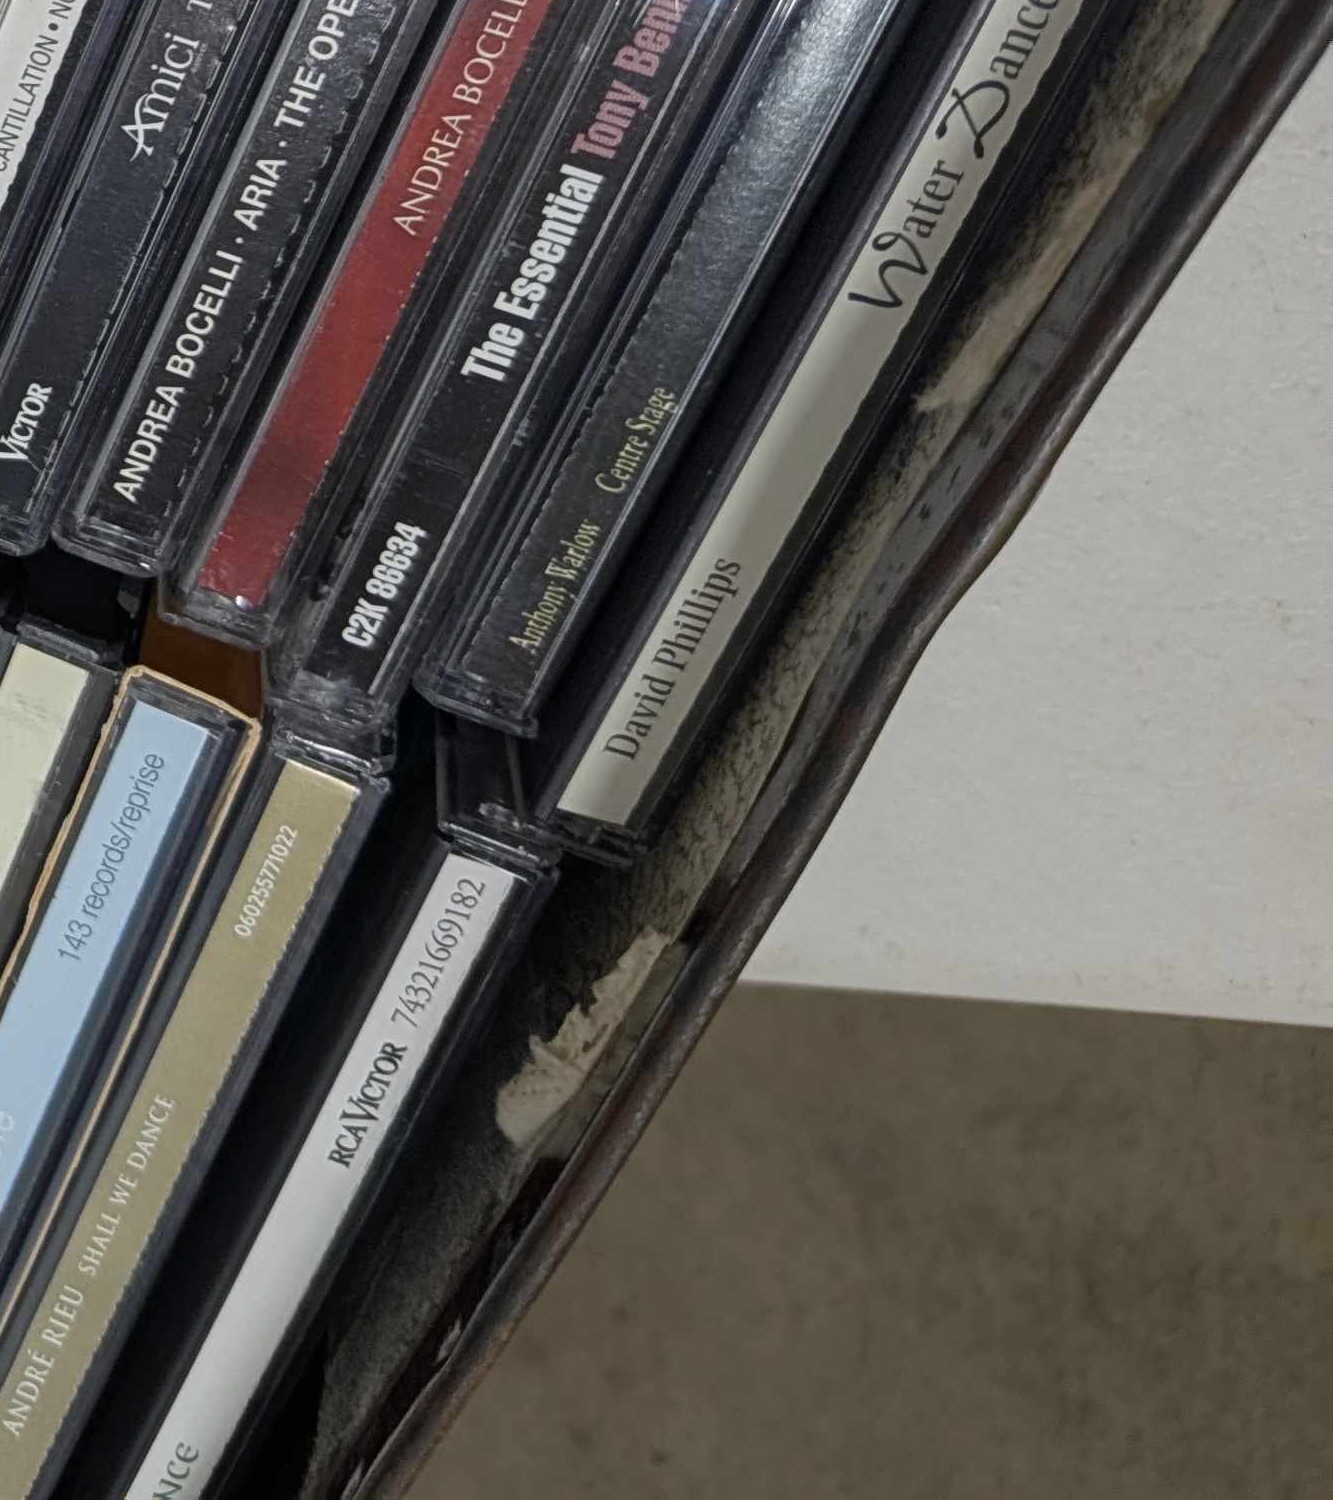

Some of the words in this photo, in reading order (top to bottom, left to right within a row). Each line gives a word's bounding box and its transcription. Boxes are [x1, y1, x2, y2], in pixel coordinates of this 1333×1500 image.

[394, 114, 470, 234] ANDREA
[569, 80, 648, 157] Tony
[114, 386, 182, 500] ANDREA
[166, 251, 241, 376] BOCELLI
[234, 159, 285, 229] ARIA
[274, 66, 325, 126] THE
[492, 156, 604, 325] Essential
[459, 313, 527, 390] The
[362, 515, 429, 604] 86634
[509, 585, 576, 654] Anthony
[545, 523, 599, 579] Warlow
[600, 666, 675, 759] David
[651, 546, 739, 669] Phillips
[391, 879, 484, 1026] 74321669182
[2, 1348, 53, 1436] ANDRÉ
[78, 1213, 118, 1275] SHALL
[126, 1096, 173, 1169] DANCE
